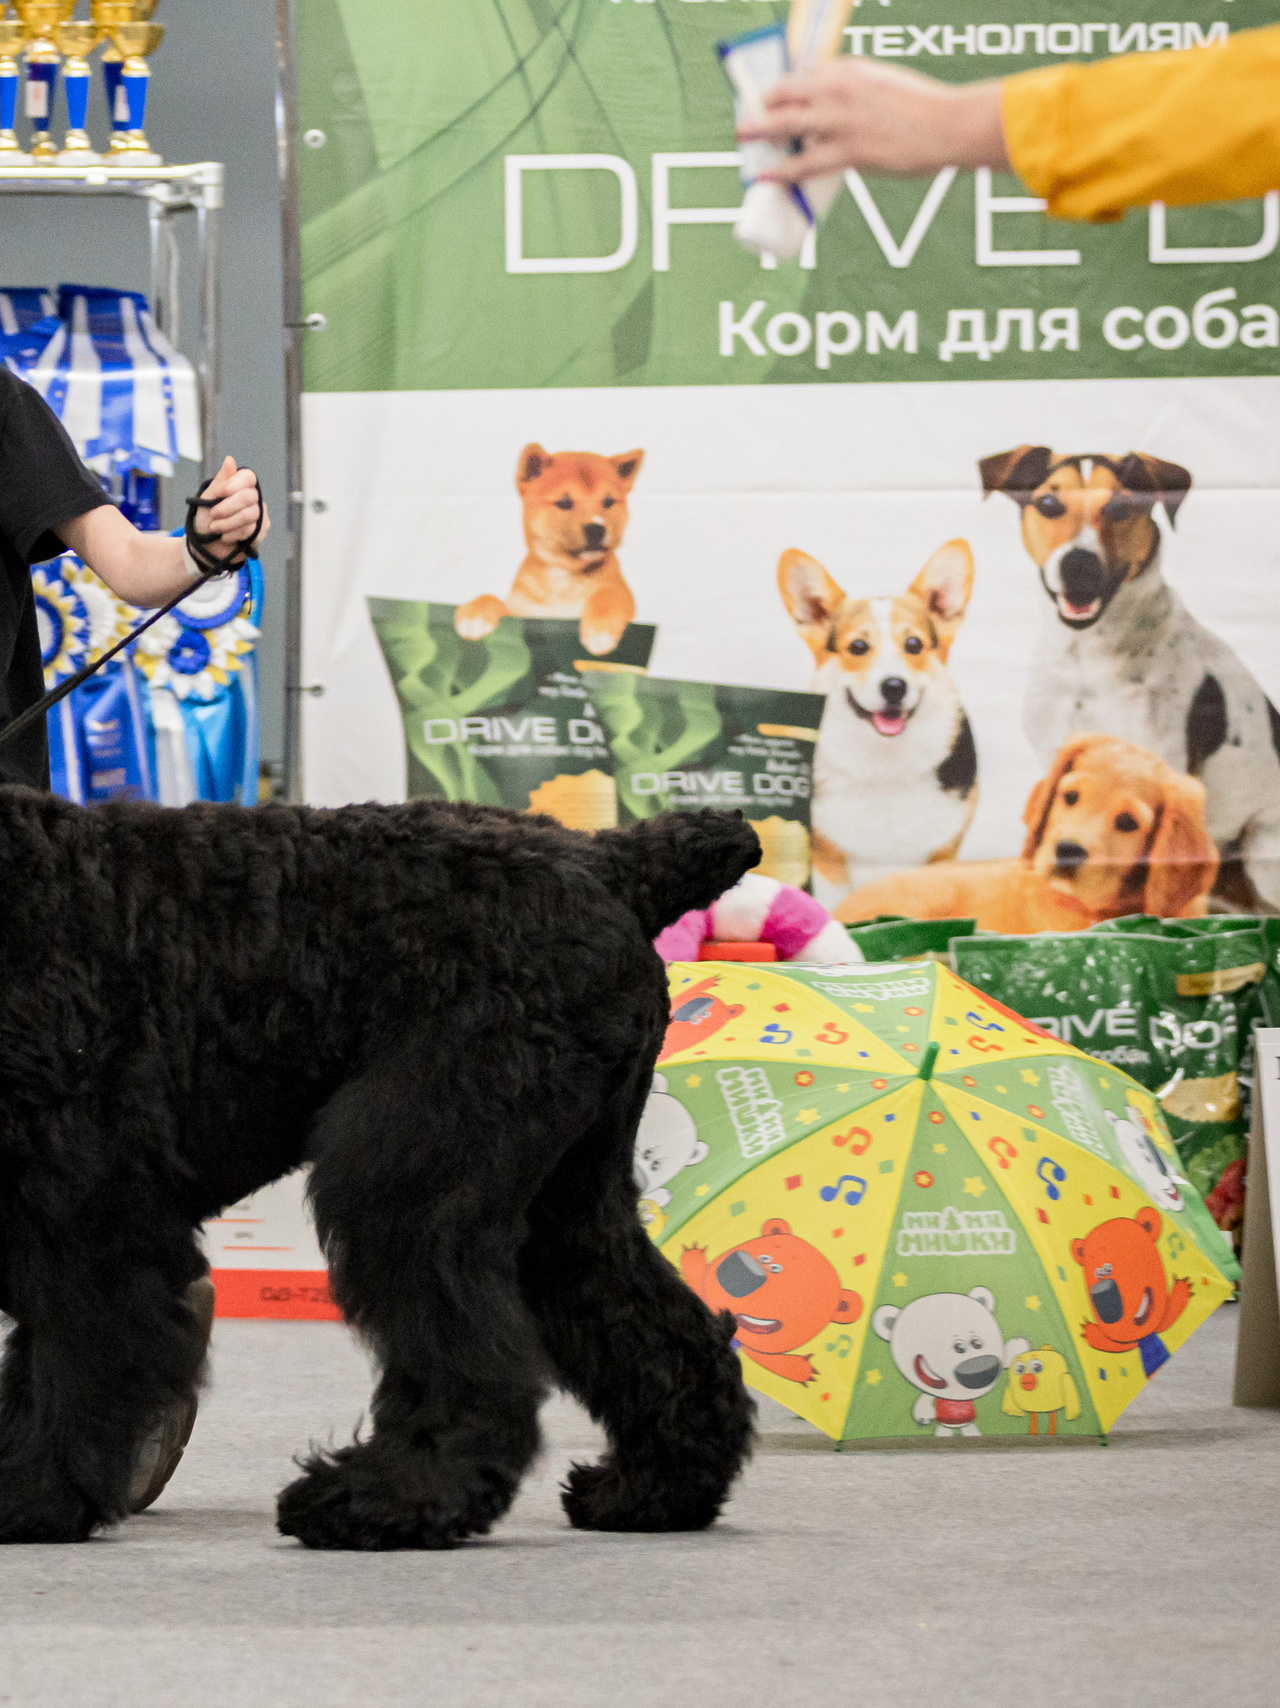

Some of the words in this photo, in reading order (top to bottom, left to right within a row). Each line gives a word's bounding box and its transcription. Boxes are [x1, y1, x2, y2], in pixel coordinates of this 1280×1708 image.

[841, 21, 1231, 57] ТЕХНОЛОГИЯМ
[504, 150, 1081, 273] DRVE
[720, 301, 917, 369] Корм
[939, 308, 1080, 361] для
[423, 717, 557, 744] DRIVE
[631, 771, 744, 795] DRIVE
[1030, 1008, 1138, 1043] RIVE
